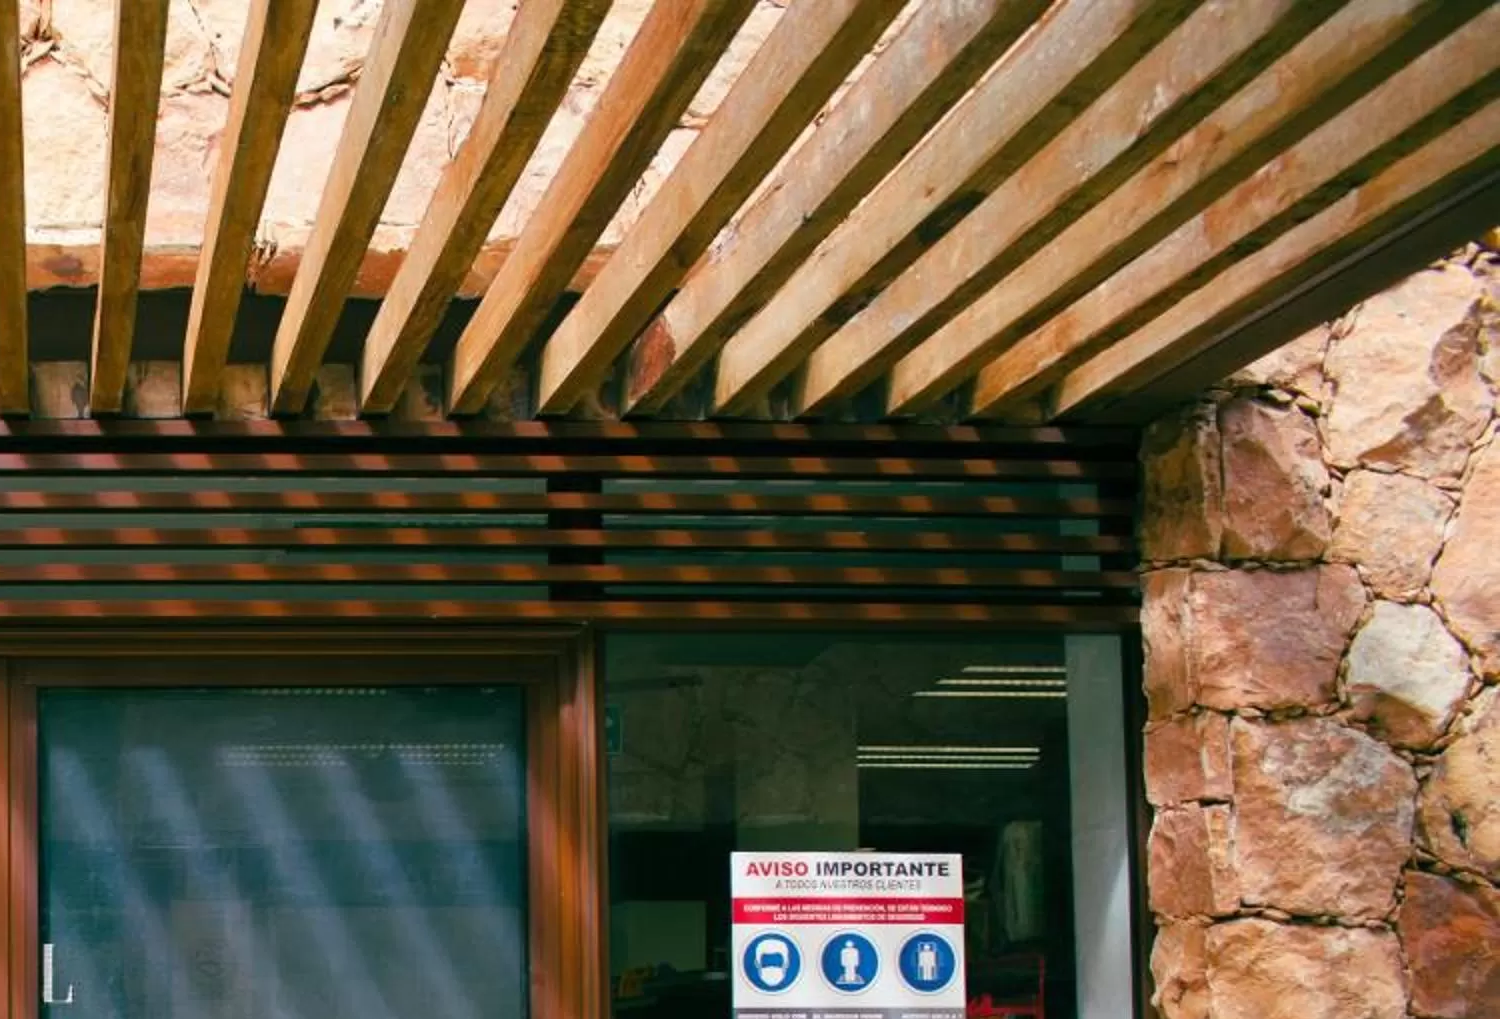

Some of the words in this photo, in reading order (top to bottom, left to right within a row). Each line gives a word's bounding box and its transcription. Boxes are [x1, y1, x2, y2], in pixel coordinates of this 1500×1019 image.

[745, 861, 809, 877] AVISO
[816, 861, 950, 877] IMPORTANTE
[784, 879, 817, 890] TODOS
